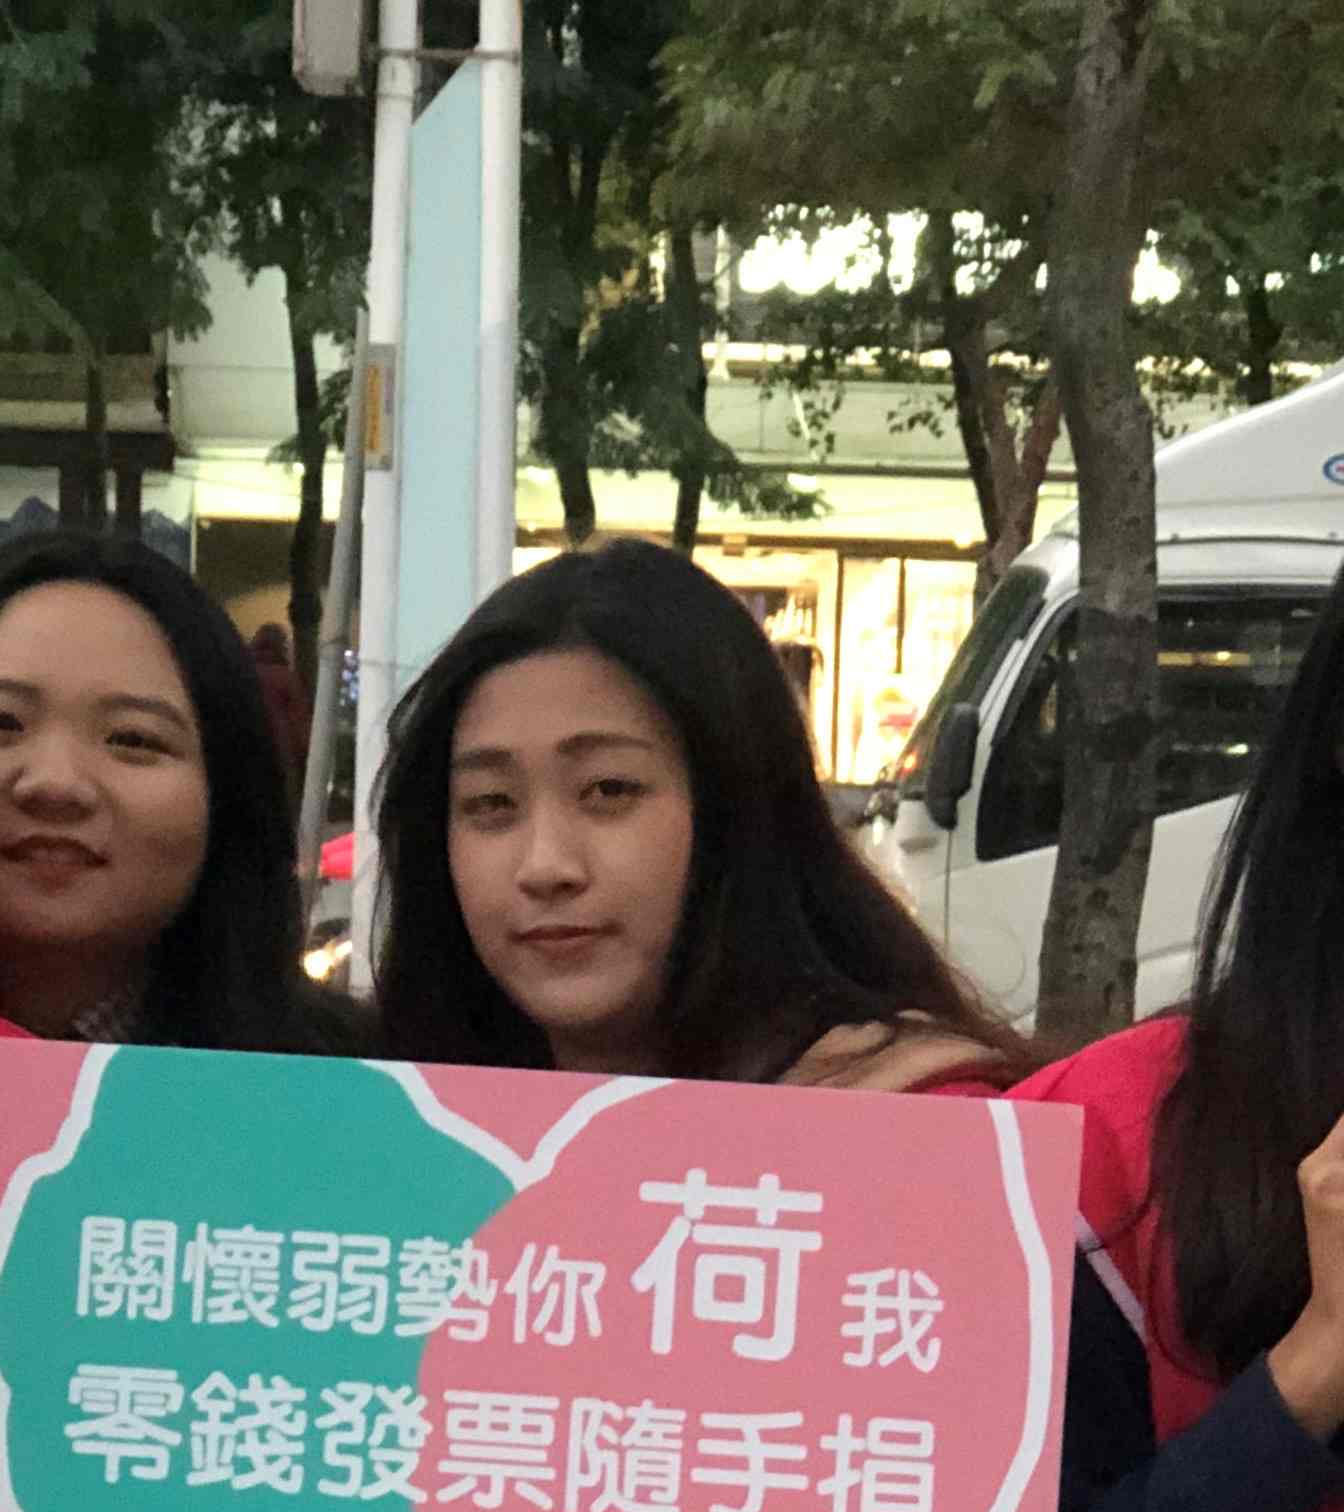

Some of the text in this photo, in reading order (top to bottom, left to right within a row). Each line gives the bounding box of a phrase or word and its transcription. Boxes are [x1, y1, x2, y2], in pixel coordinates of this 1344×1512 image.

[74, 1168, 945, 1374] 關懷弱勢你荷我
